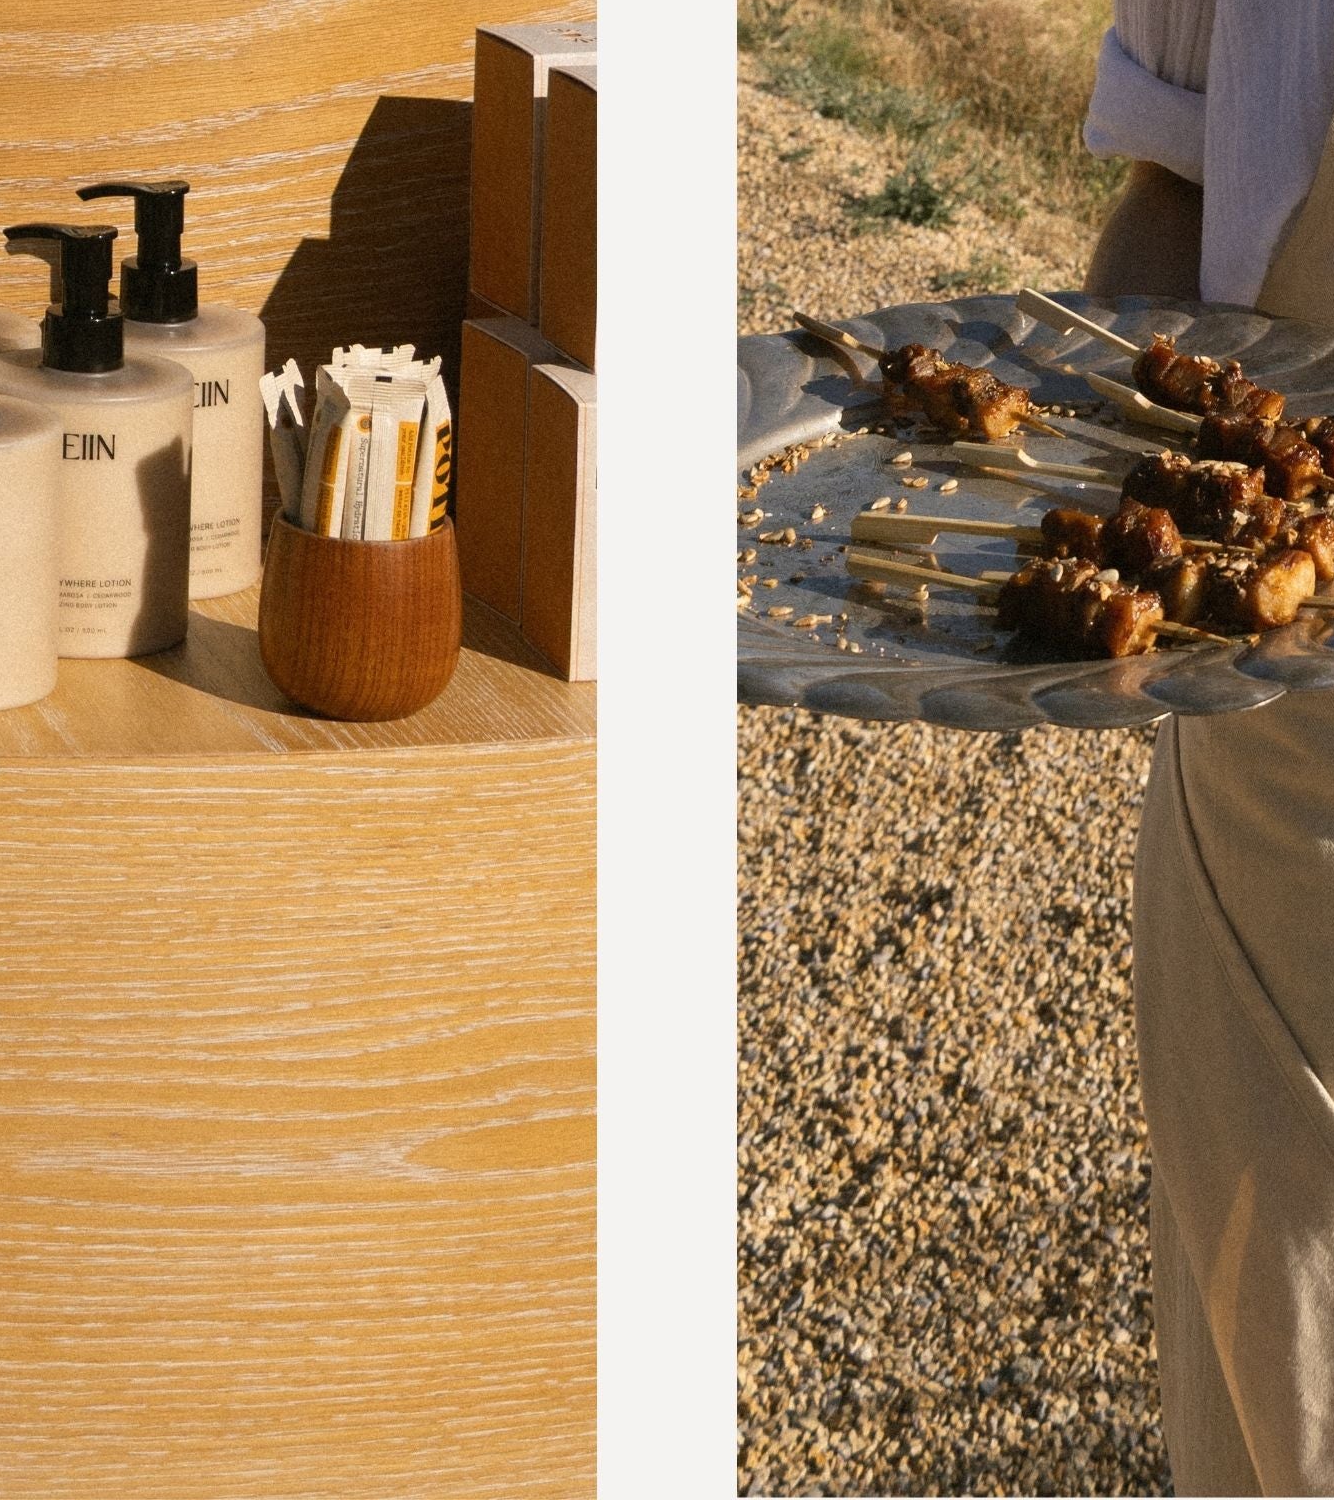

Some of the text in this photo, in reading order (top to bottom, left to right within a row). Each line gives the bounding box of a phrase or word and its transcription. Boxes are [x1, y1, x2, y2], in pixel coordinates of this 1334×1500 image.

[62, 433, 116, 460] EIIN
[216, 518, 240, 529] LOTION
[100, 579, 131, 588] LOTION
